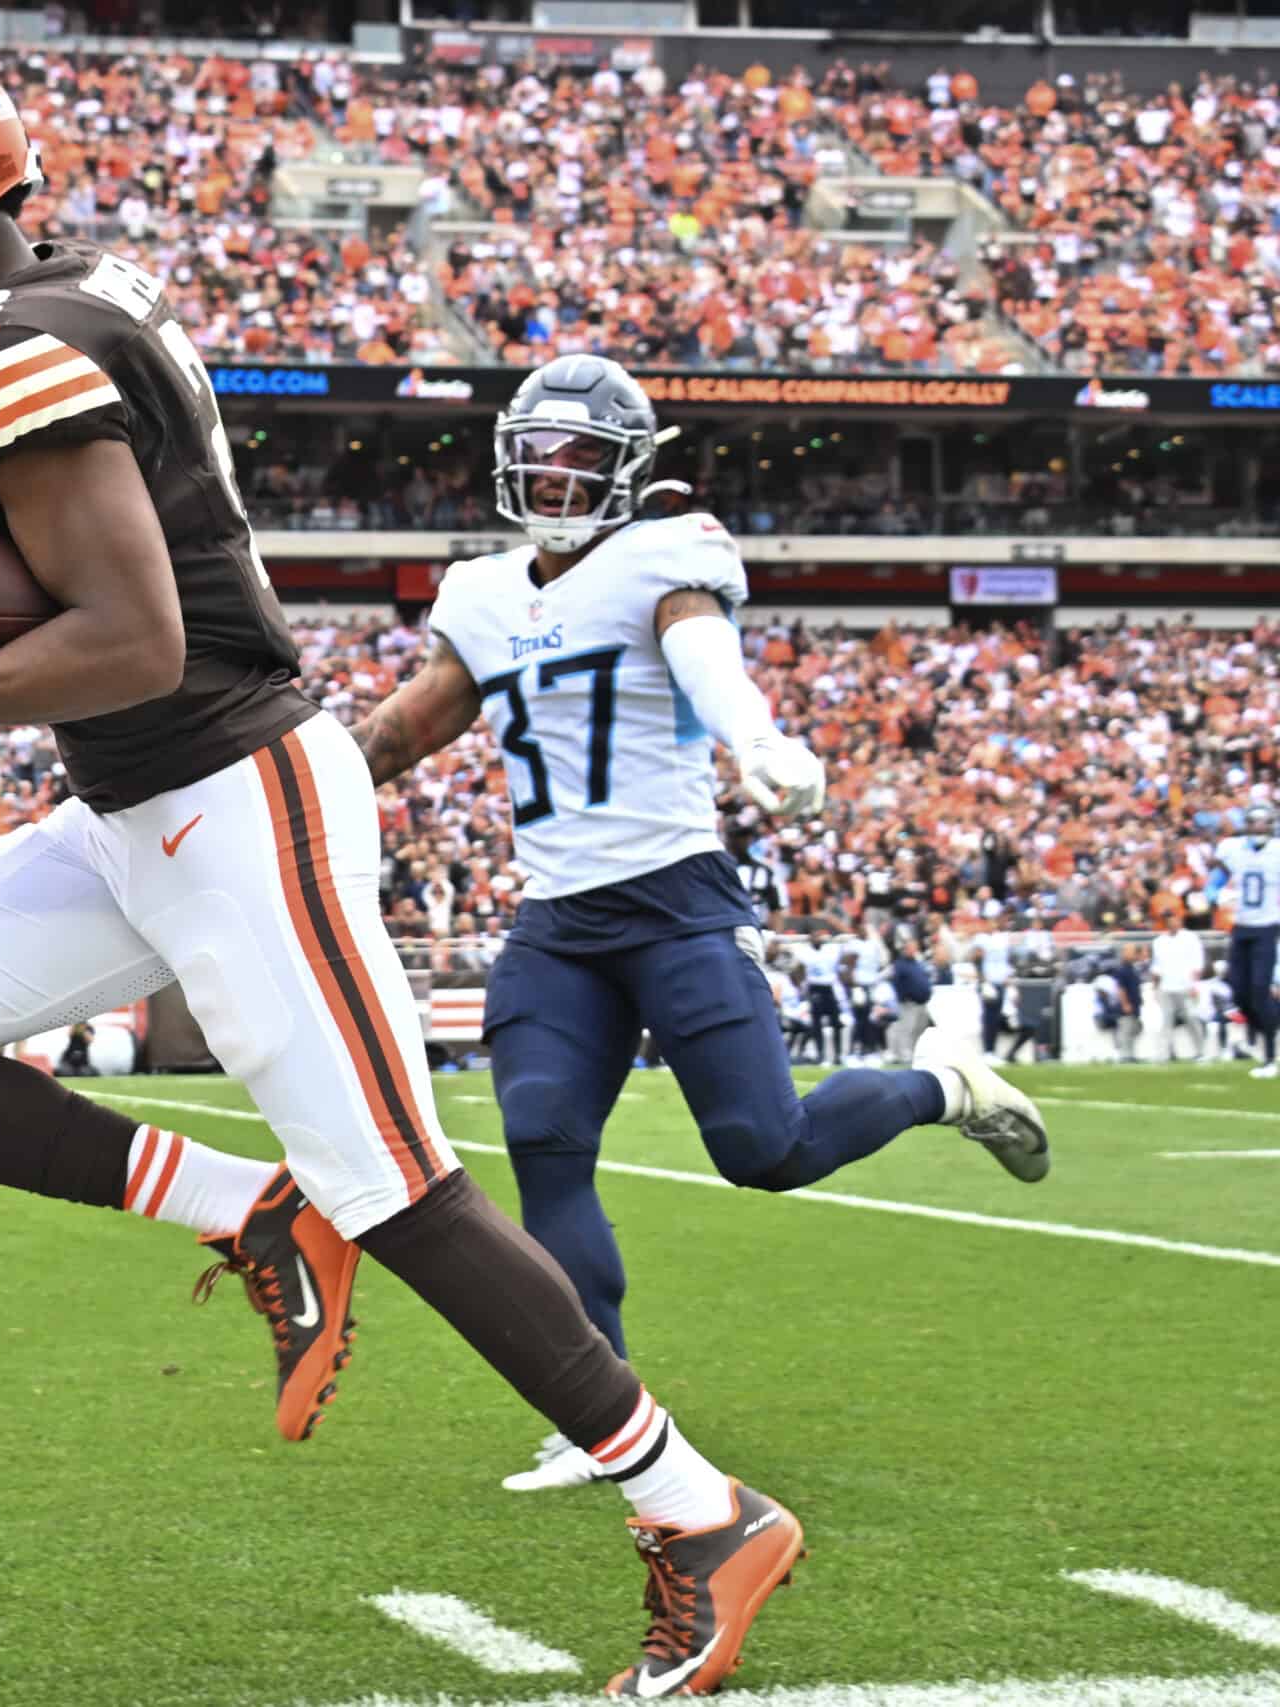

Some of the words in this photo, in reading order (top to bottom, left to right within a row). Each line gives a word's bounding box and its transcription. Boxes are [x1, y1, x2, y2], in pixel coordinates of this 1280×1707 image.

[669, 377, 686, 400] &
[686, 376, 781, 403] SCALING
[781, 378, 908, 404] COMPANIES
[911, 380, 1010, 406] LOCALLY
[478, 642, 629, 830] 37
[1243, 870, 1265, 908] 0
